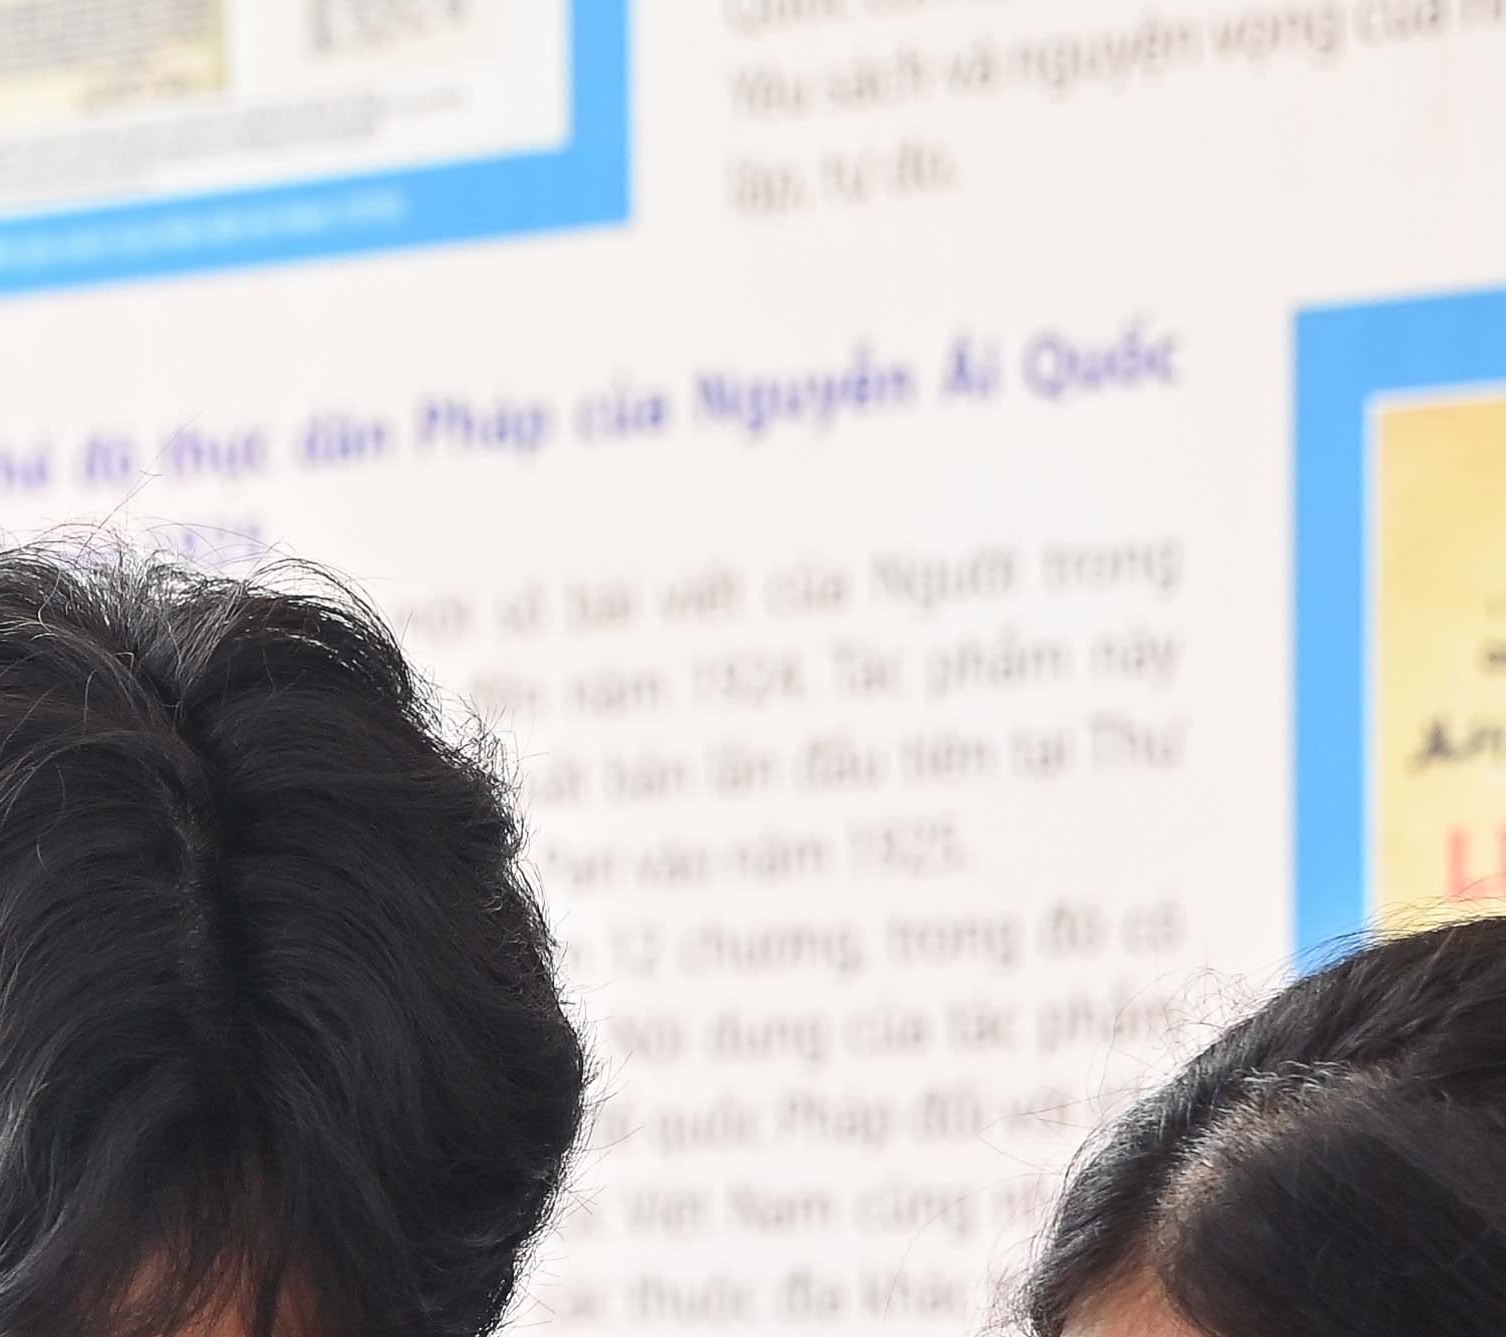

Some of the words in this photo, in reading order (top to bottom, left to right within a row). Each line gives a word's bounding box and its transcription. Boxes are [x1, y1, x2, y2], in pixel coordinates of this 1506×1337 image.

[416, 396, 550, 452] Pháp
[576, 385, 668, 438] của
[694, 344, 915, 438] Nguyễn
[943, 334, 998, 400] Ái
[1022, 321, 1177, 402] Quốc
[871, 544, 1018, 614] Người
[1040, 536, 1184, 600] trong
